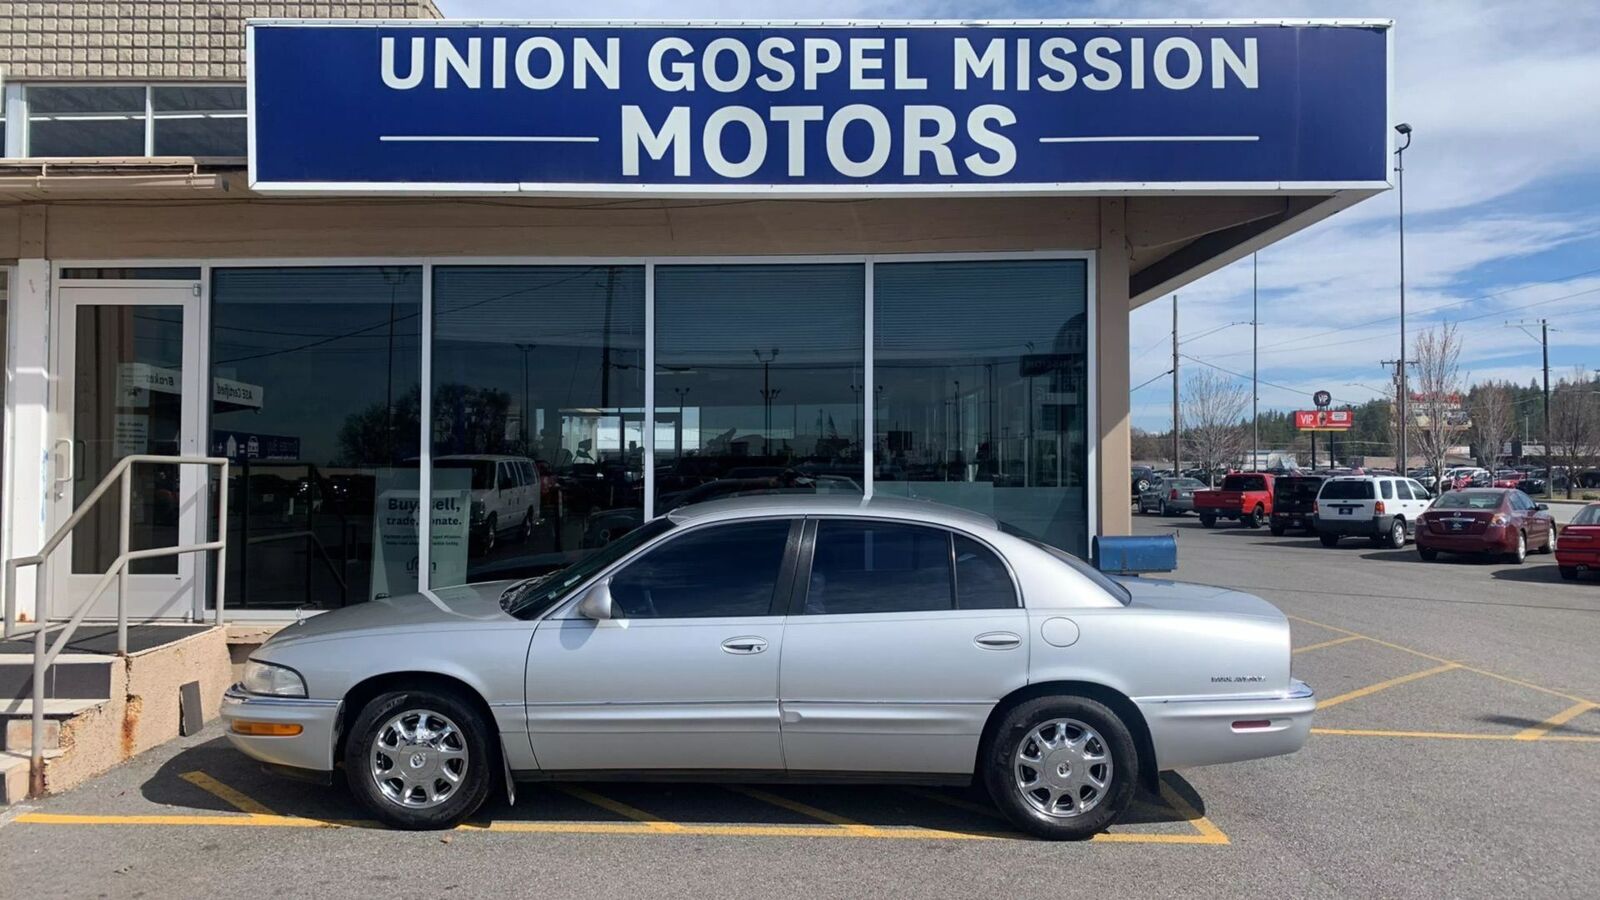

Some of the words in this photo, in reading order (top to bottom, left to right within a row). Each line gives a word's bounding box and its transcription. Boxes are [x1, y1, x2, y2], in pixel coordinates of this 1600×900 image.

[381, 37, 620, 90] UNION
[647, 37, 929, 92] GOSPEL
[954, 37, 1259, 91] MISSION
[621, 104, 1017, 178] MOTORS
[1317, 394, 1329, 404] VIP
[1301, 415, 1314, 425] VIP
[431, 498, 460, 512] ell,
